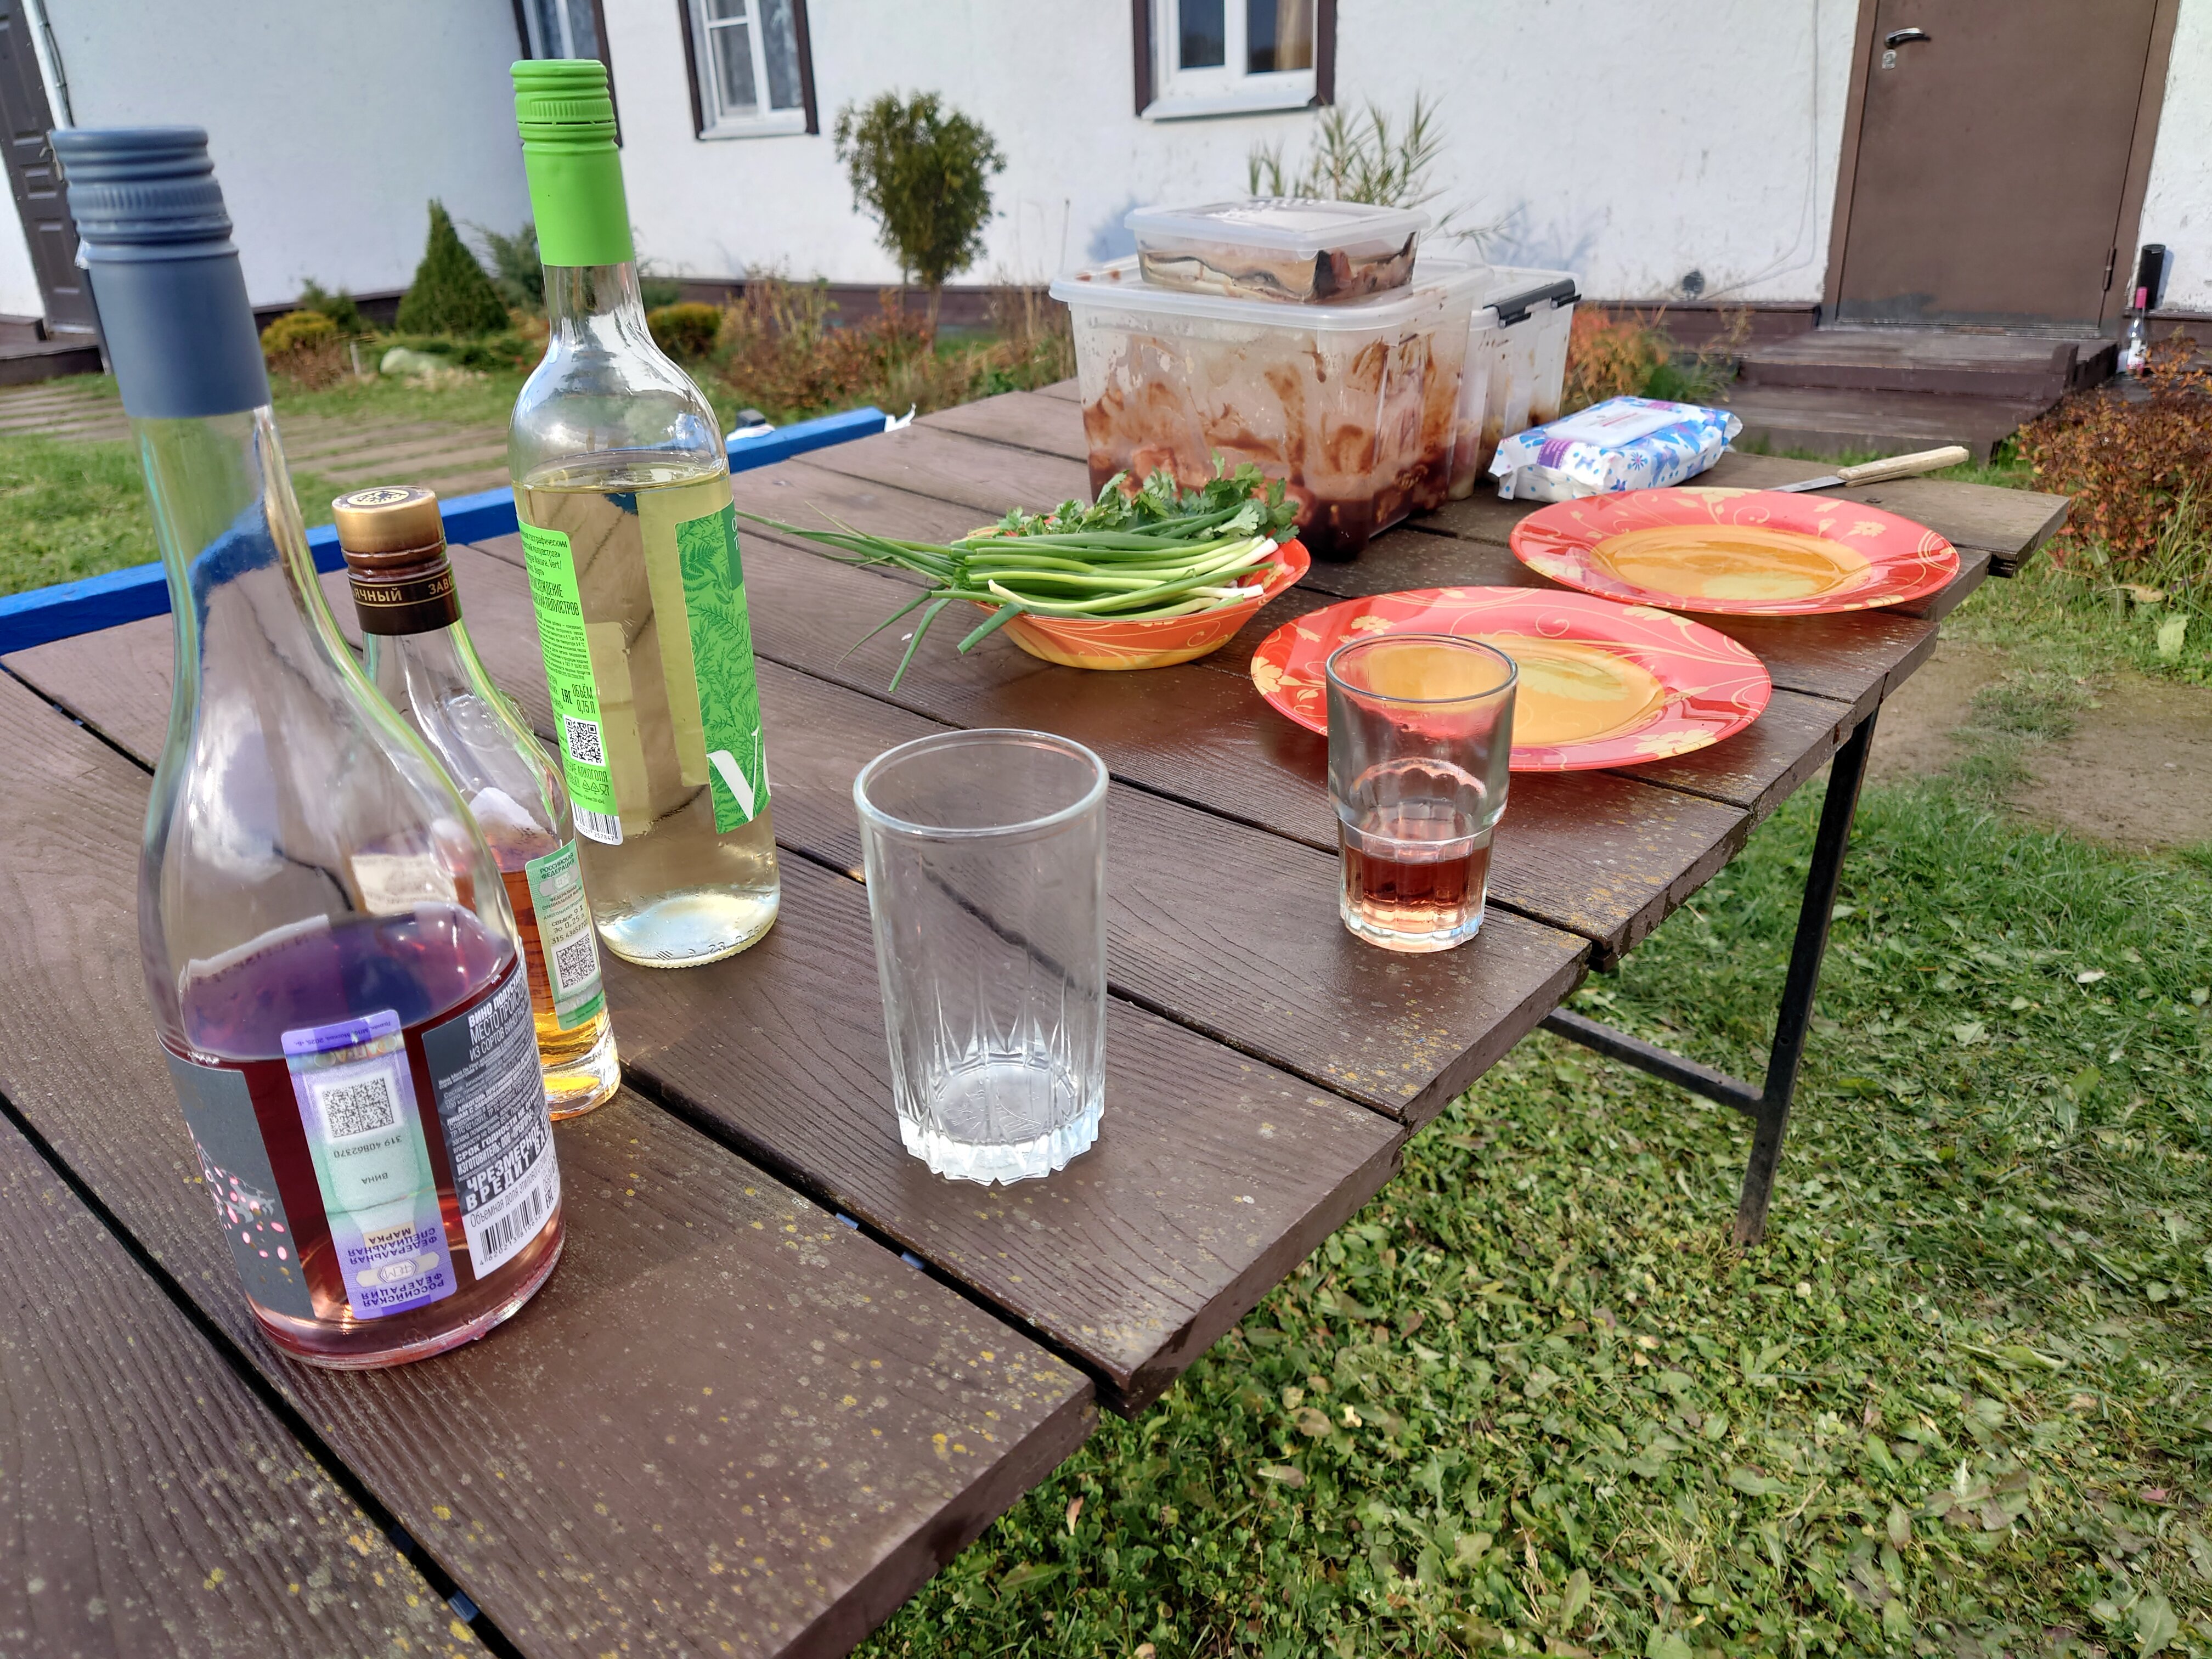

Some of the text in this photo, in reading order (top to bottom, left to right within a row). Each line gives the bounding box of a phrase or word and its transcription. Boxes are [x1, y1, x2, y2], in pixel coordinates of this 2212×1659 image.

[428, 575, 453, 595] ЗАВО
[572, 684, 594, 699] ОБЪЁМ
[577, 699, 590, 714] 0,75
[578, 766, 608, 782] АЛКОГОЛЯ
[706, 725, 771, 821] V
[594, 832, 614, 841] 257847
[540, 852, 574, 874] РОССИЙСКАЯ
[541, 858, 575, 879] ФЕДЕРАЦИЯ
[542, 892, 573, 910] СПЕЦИАЛЬНАЯ
[565, 915, 580, 929] 0,25
[551, 935, 564, 944] 315
[467, 999, 493, 1029] ВИНО
[469, 1008, 499, 1046] МЕСТО
[469, 1044, 481, 1062] ИЗ
[480, 1024, 505, 1055] СОРТОВ
[445, 1109, 469, 1126] ЛИЦАМ
[469, 1105, 474, 1114] С
[473, 1076, 513, 1111] ЗАБОЛЕВАНИЯМИ
[445, 1101, 456, 1110] 100
[457, 1092, 486, 1113] АЛКОГОЛЬ
[448, 1108, 482, 1132] Содержание
[449, 1128, 458, 1139] ТР
[458, 1125, 465, 1135] ТС
[465, 1111, 488, 1131] 021/2011,
[487, 1107, 494, 1117] ТР
[493, 1102, 500, 1113] ТС
[451, 1132, 470, 1147] запаха
[452, 1133, 481, 1154] влажности
[480, 1130, 487, 1138] не
[486, 1119, 500, 1135] более
[454, 1142, 481, 1164] СРОК
[481, 1114, 518, 1149] ГОДНОСТИ
[517, 1105, 526, 1120] НЕ
[334, 1136, 402, 1158] 319 40862370
[455, 1139, 501, 1176] ИЗГОТОВИТЕЛЬ:
[500, 1130, 511, 1149] ООО
[465, 1118, 541, 1195] ЧРЕЗМЕРНОЕ
[464, 1115, 549, 1212] ВРЕДИТ ВАШ
[362, 1173, 388, 1184] ВИНА
[469, 1197, 505, 1229] Объемная
[504, 1186, 519, 1207] доля
[518, 1161, 540, 1195] этилового
[348, 1228, 436, 1256] СПЕЦИАЛЬНАЯ
[369, 1228, 411, 1244] МАРКА
[350, 1237, 437, 1265] ФЕДЕРАЛЬНАЯ
[362, 1273, 442, 1300] ФЕДЕРАЦИЯ
[363, 1279, 444, 1307] РОССИЙСКАЯ
